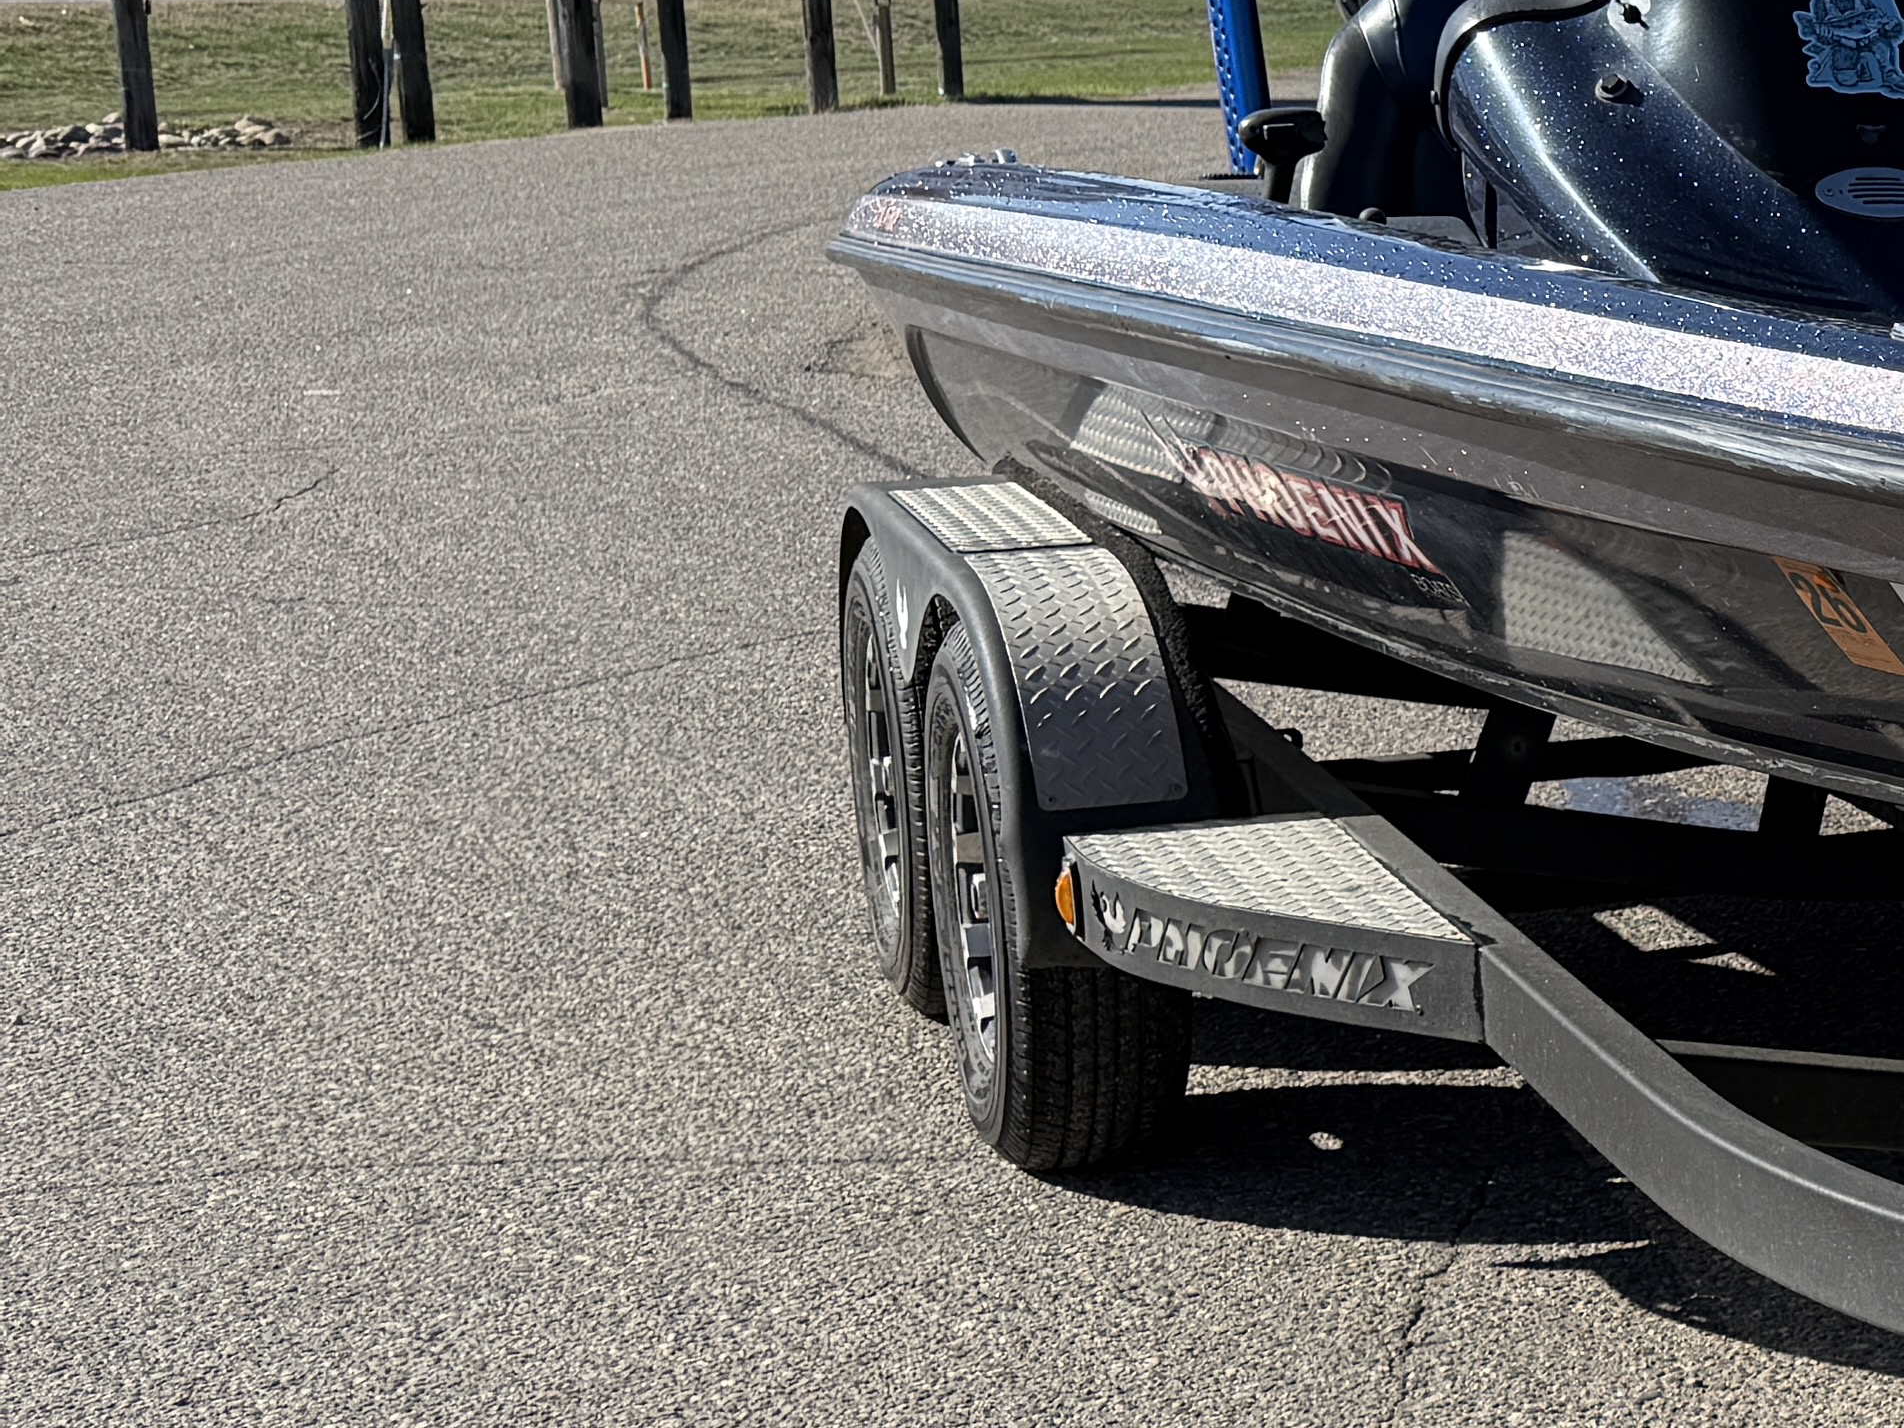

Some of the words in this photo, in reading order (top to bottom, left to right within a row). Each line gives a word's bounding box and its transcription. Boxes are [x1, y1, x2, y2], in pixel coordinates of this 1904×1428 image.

[1199, 444, 1444, 576] PHOENIX
[1788, 572, 1868, 634] 26
[1124, 907, 1436, 1012] PHOENIX
